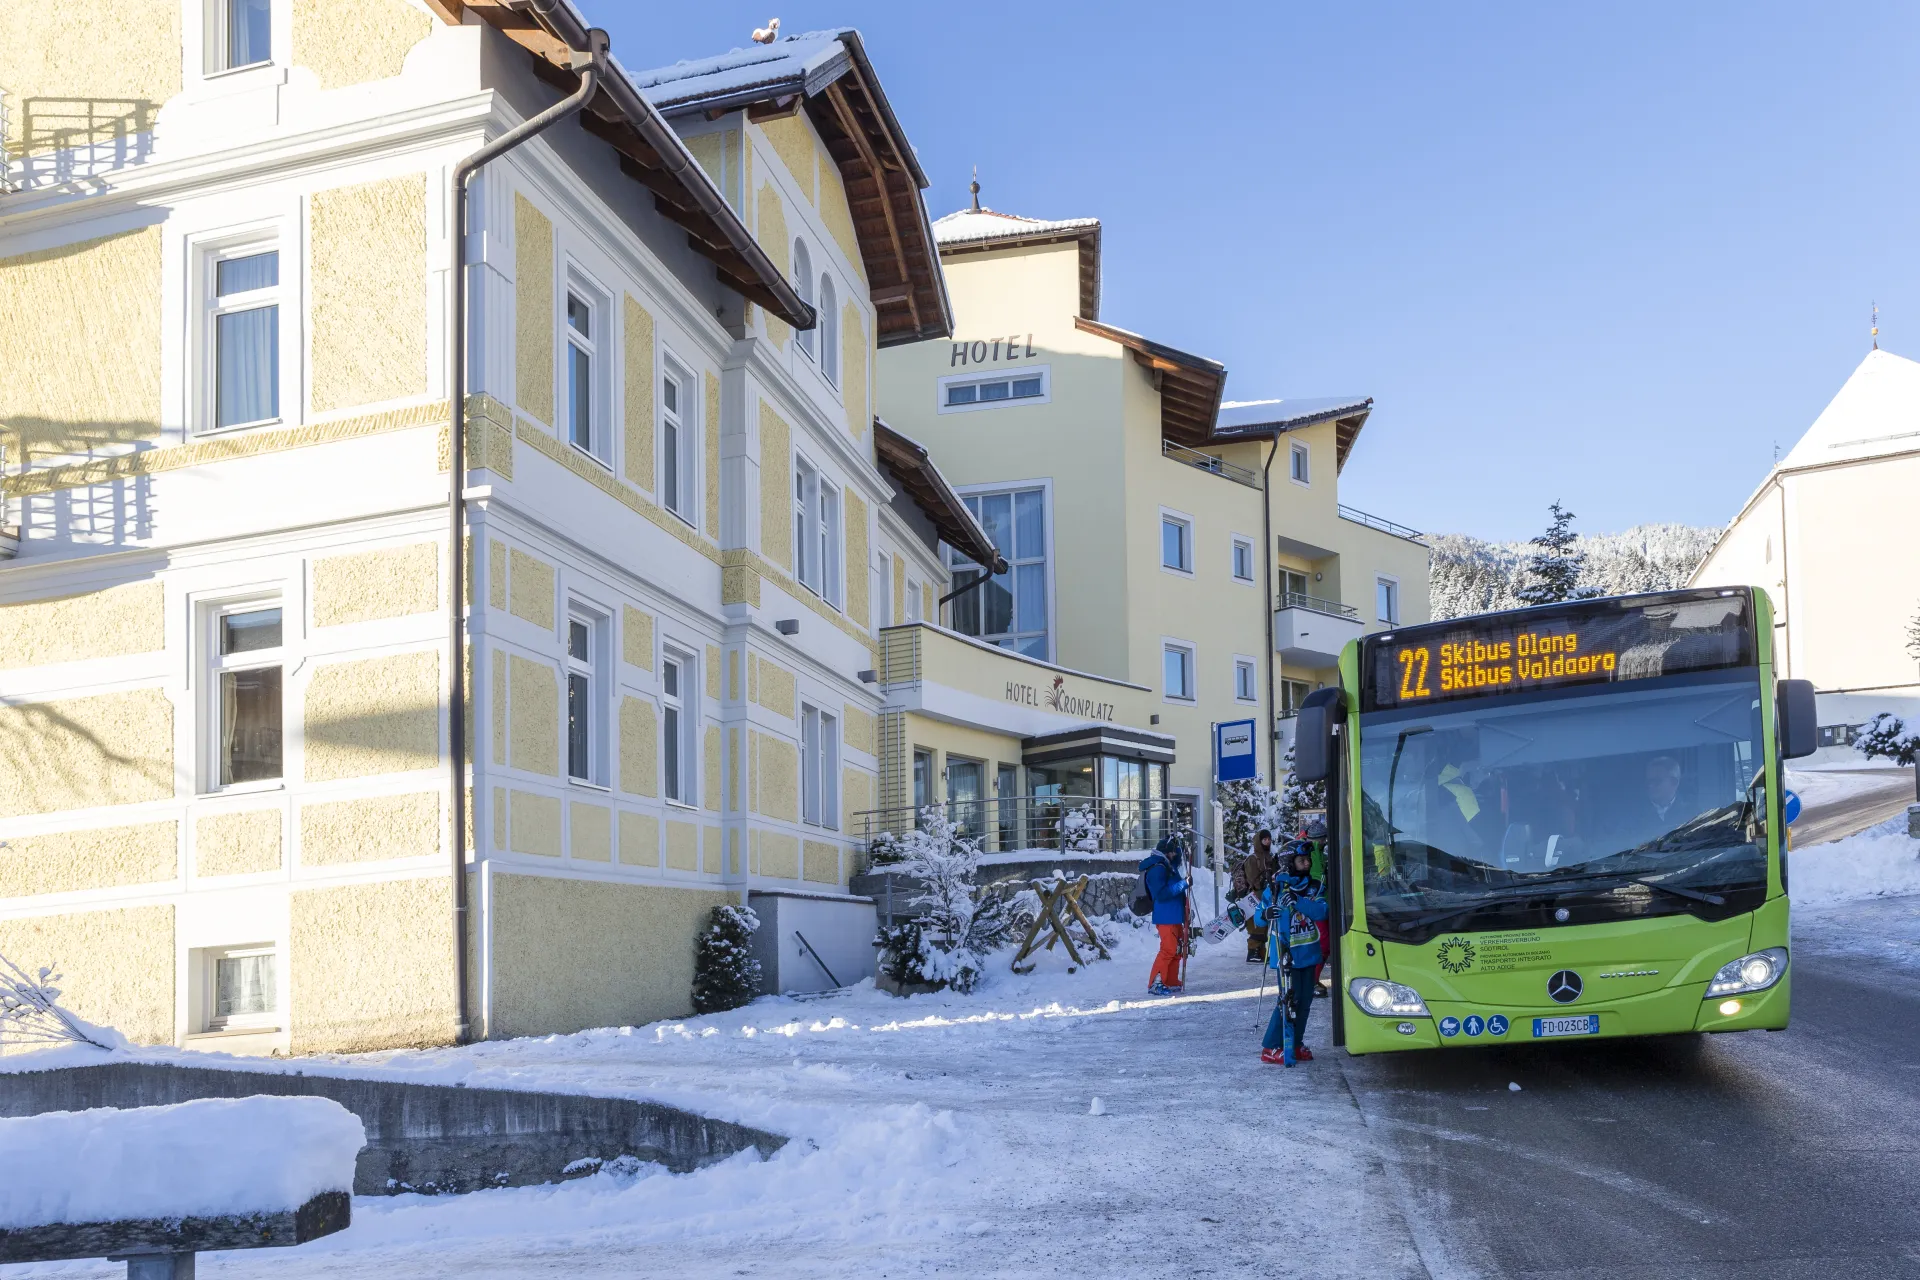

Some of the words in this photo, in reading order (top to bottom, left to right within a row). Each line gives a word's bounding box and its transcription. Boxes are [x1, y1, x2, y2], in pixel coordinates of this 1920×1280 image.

[951, 334, 1037, 367] HOTEL
[1440, 640, 1511, 667] Skibus
[1517, 633, 1577, 657] Olang
[1399, 647, 1430, 698] 22
[1440, 664, 1512, 691] Skibus
[1517, 652, 1616, 681] Valdaora
[1005, 681, 1038, 707] HOTEL
[1480, 936, 1541, 945] VERKEHRSVERBUND
[1480, 957, 1516, 965] TRASPORTO
[1518, 954, 1552, 962] INTEGRATO
[1600, 970, 1659, 978] CITARO
